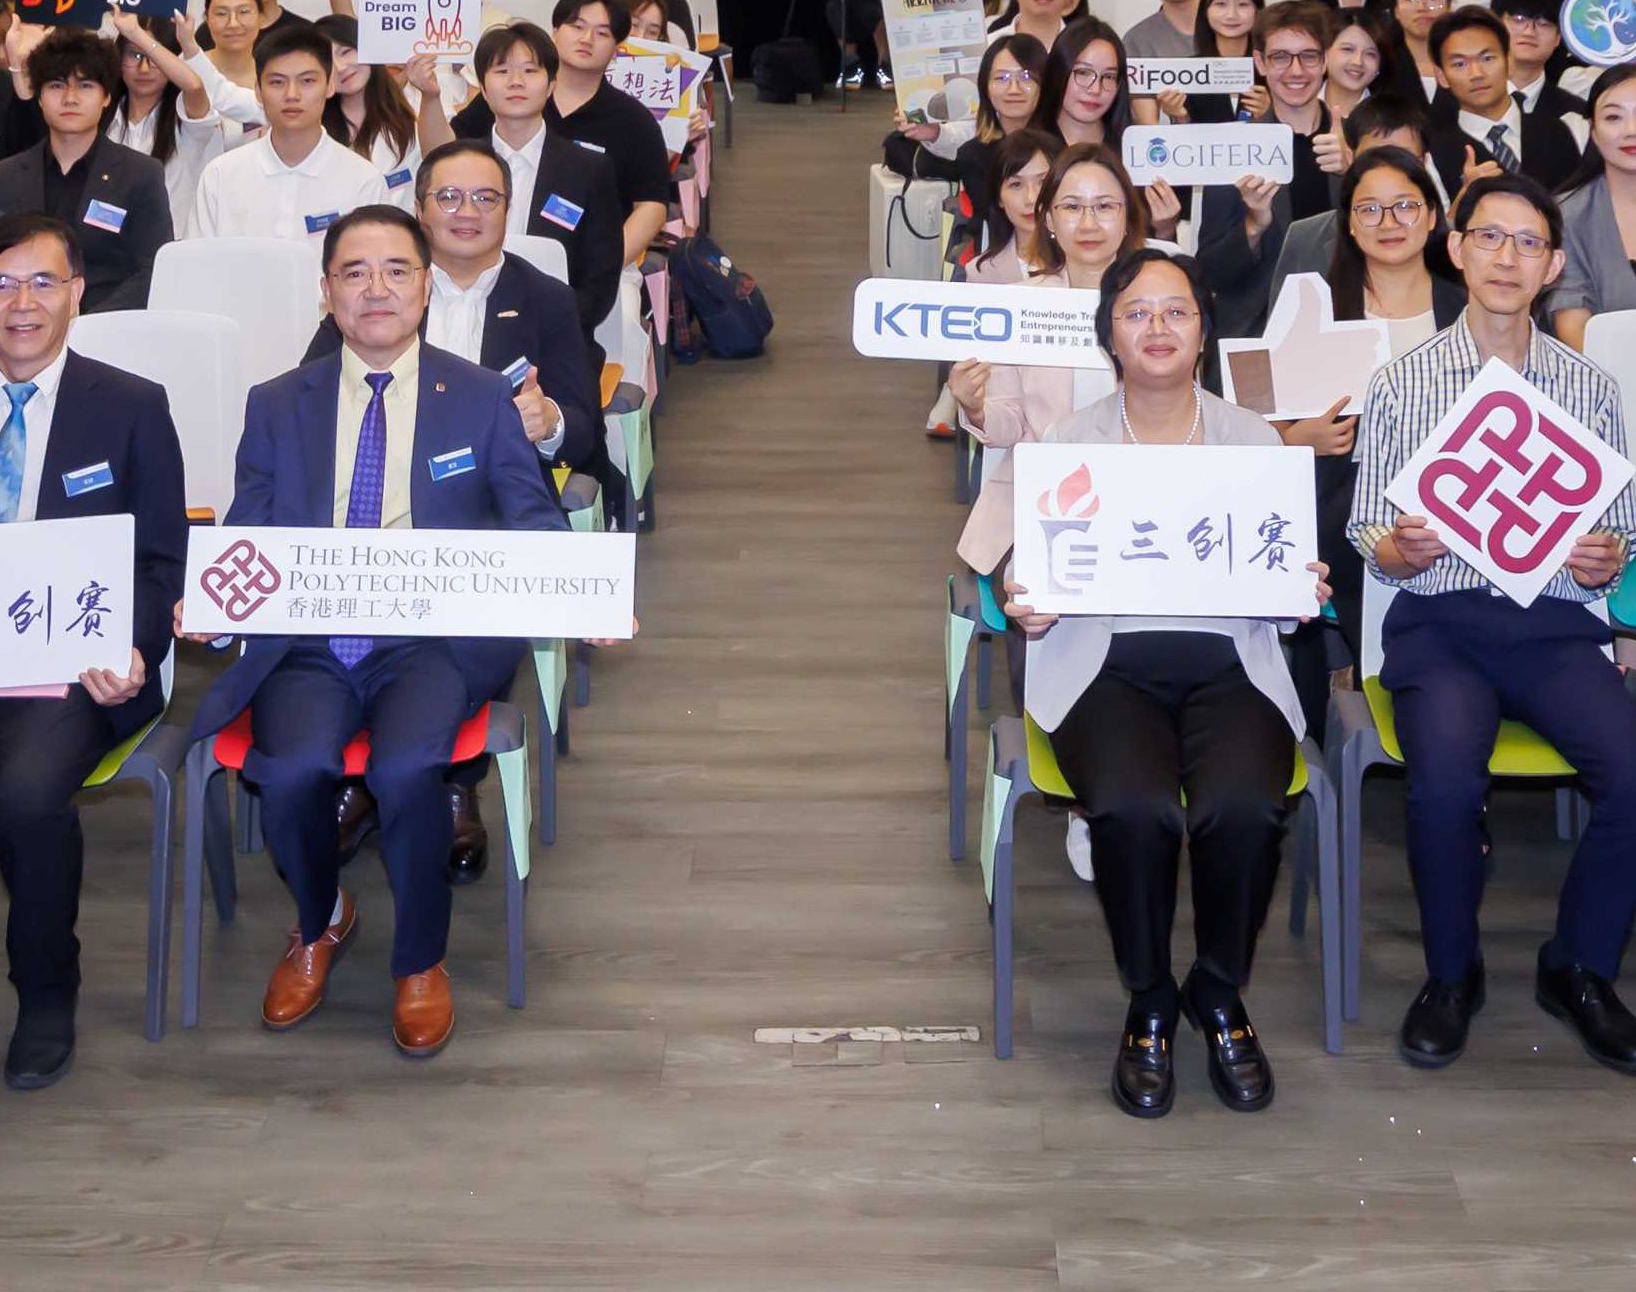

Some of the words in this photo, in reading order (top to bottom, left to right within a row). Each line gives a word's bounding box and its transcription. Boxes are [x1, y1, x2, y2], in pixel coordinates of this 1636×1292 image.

[365, 1, 417, 13] Dream
[381, 16, 416, 31] BIG
[1130, 142, 1288, 168] LOGIFERA
[874, 301, 1013, 342] KTEO
[1020, 309, 1078, 321] Knowledge
[286, 597, 432, 620] 香港理工大學
